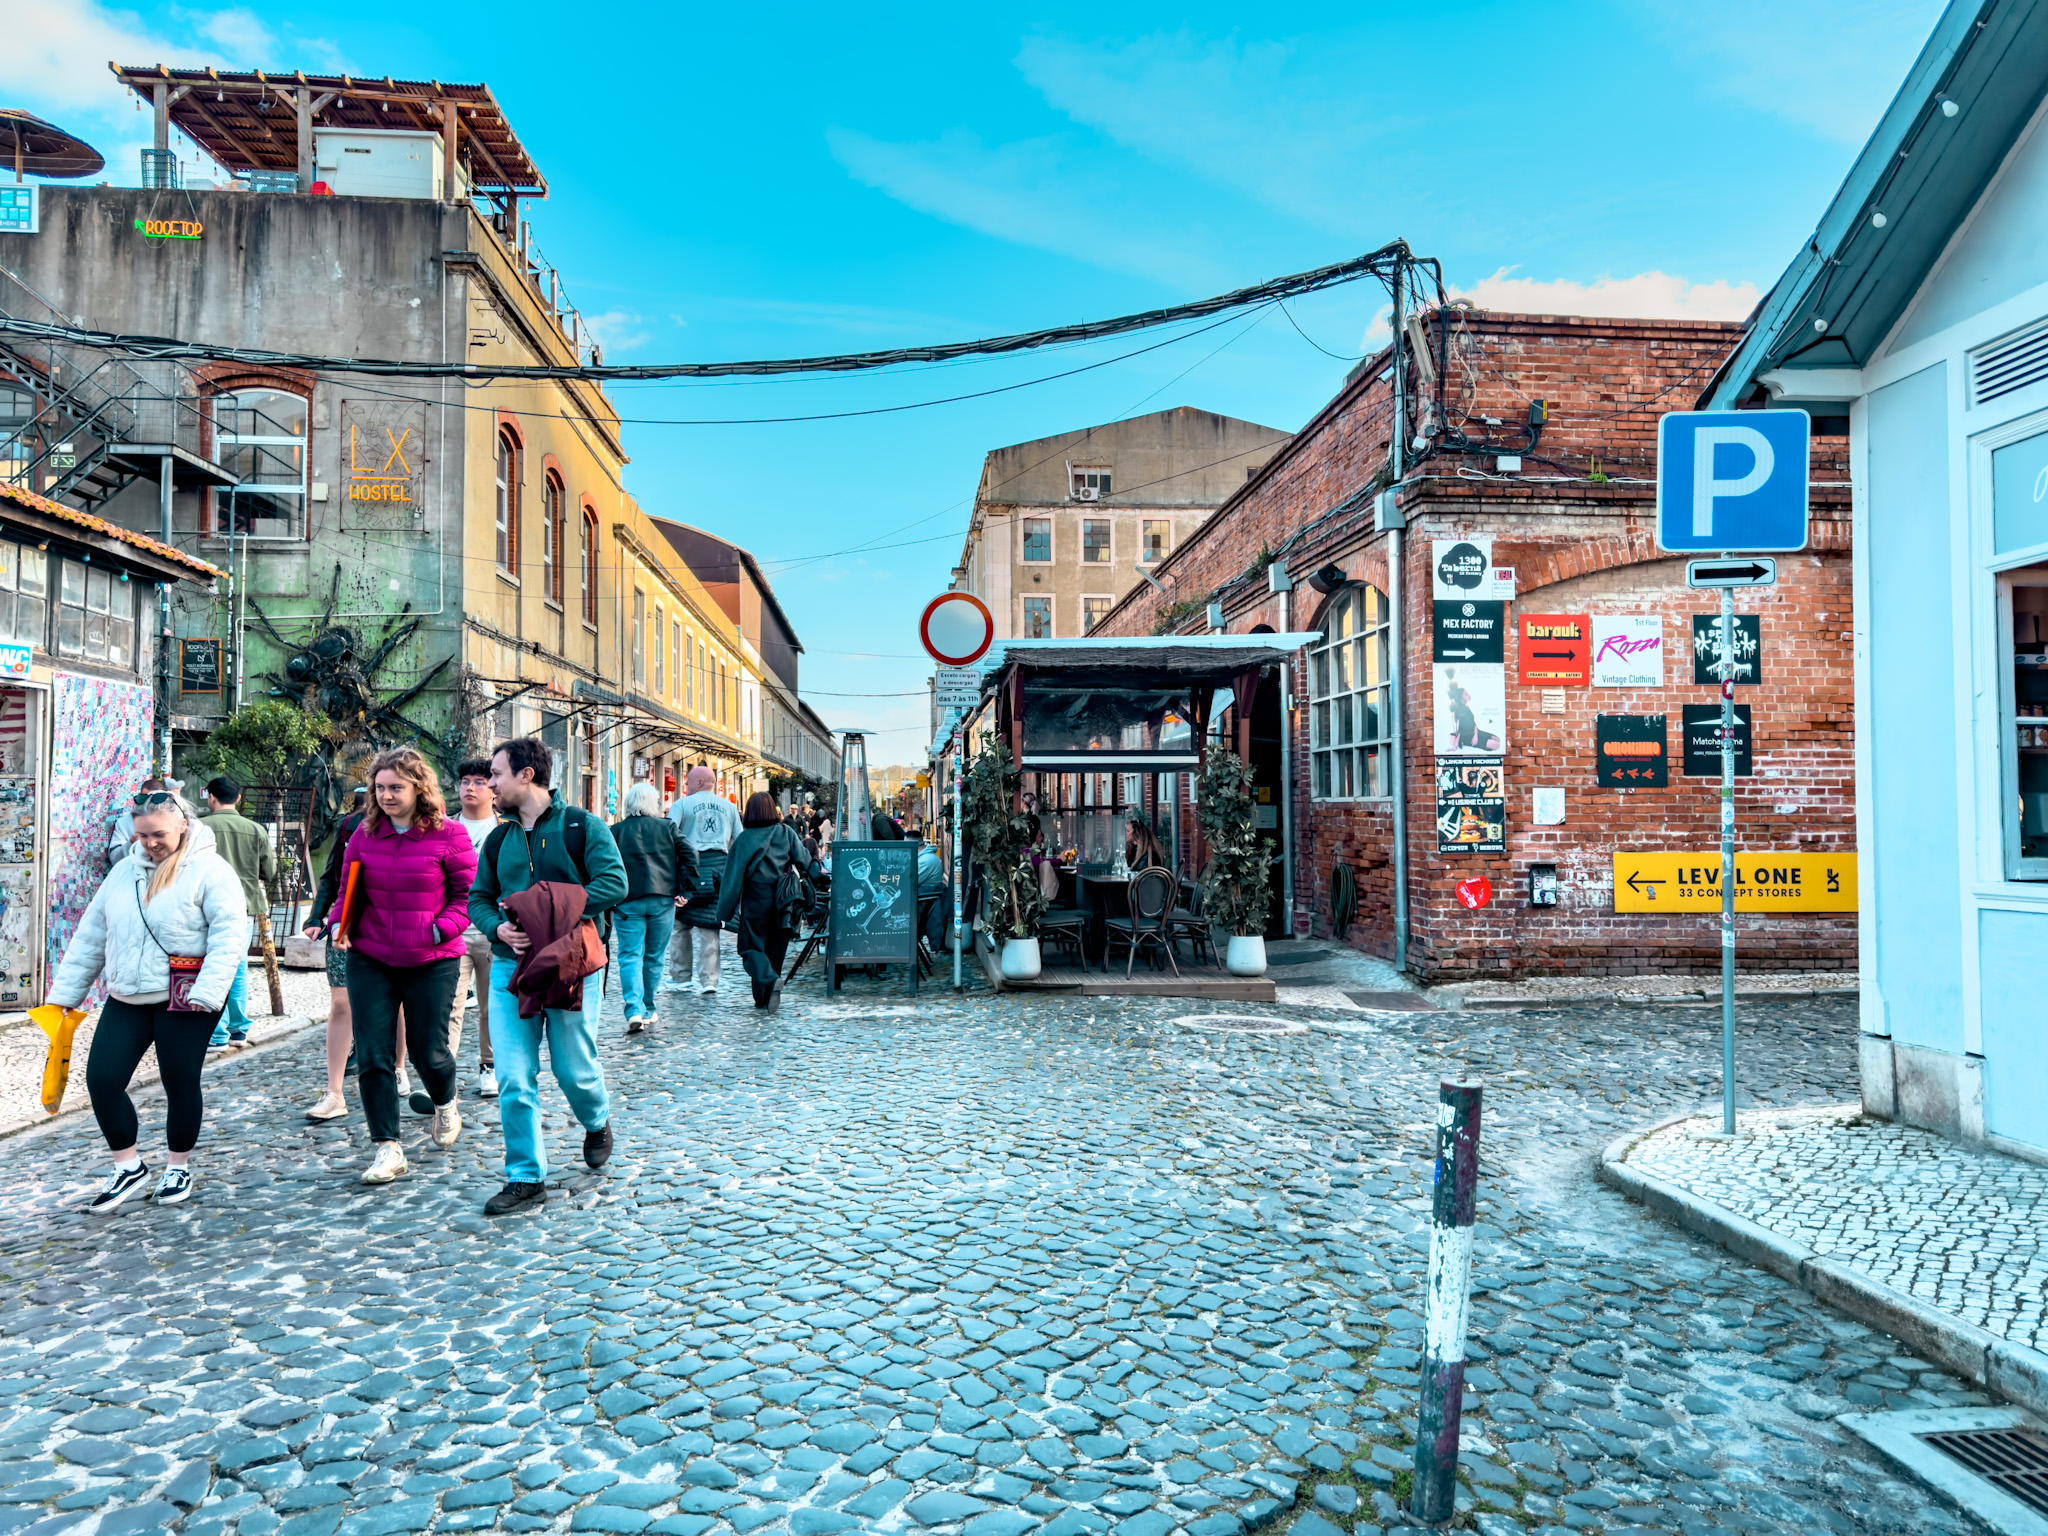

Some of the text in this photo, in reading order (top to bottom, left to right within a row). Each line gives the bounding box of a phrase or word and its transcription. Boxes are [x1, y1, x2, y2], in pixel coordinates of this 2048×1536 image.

[145, 219, 203, 237] ROOFTOP
[352, 424, 411, 474] LX
[1692, 426, 1776, 537] P
[349, 484, 411, 501] HOSTEL
[1443, 619, 1494, 629] MEX FACTORY
[1602, 675, 1656, 685] Vintage Clothing
[692, 803, 706, 815] CLUB
[880, 874, 900, 886] 15-19
[1678, 868, 1802, 885] LEVL ONE
[1679, 888, 1801, 897] 33 CONEPT STORES
